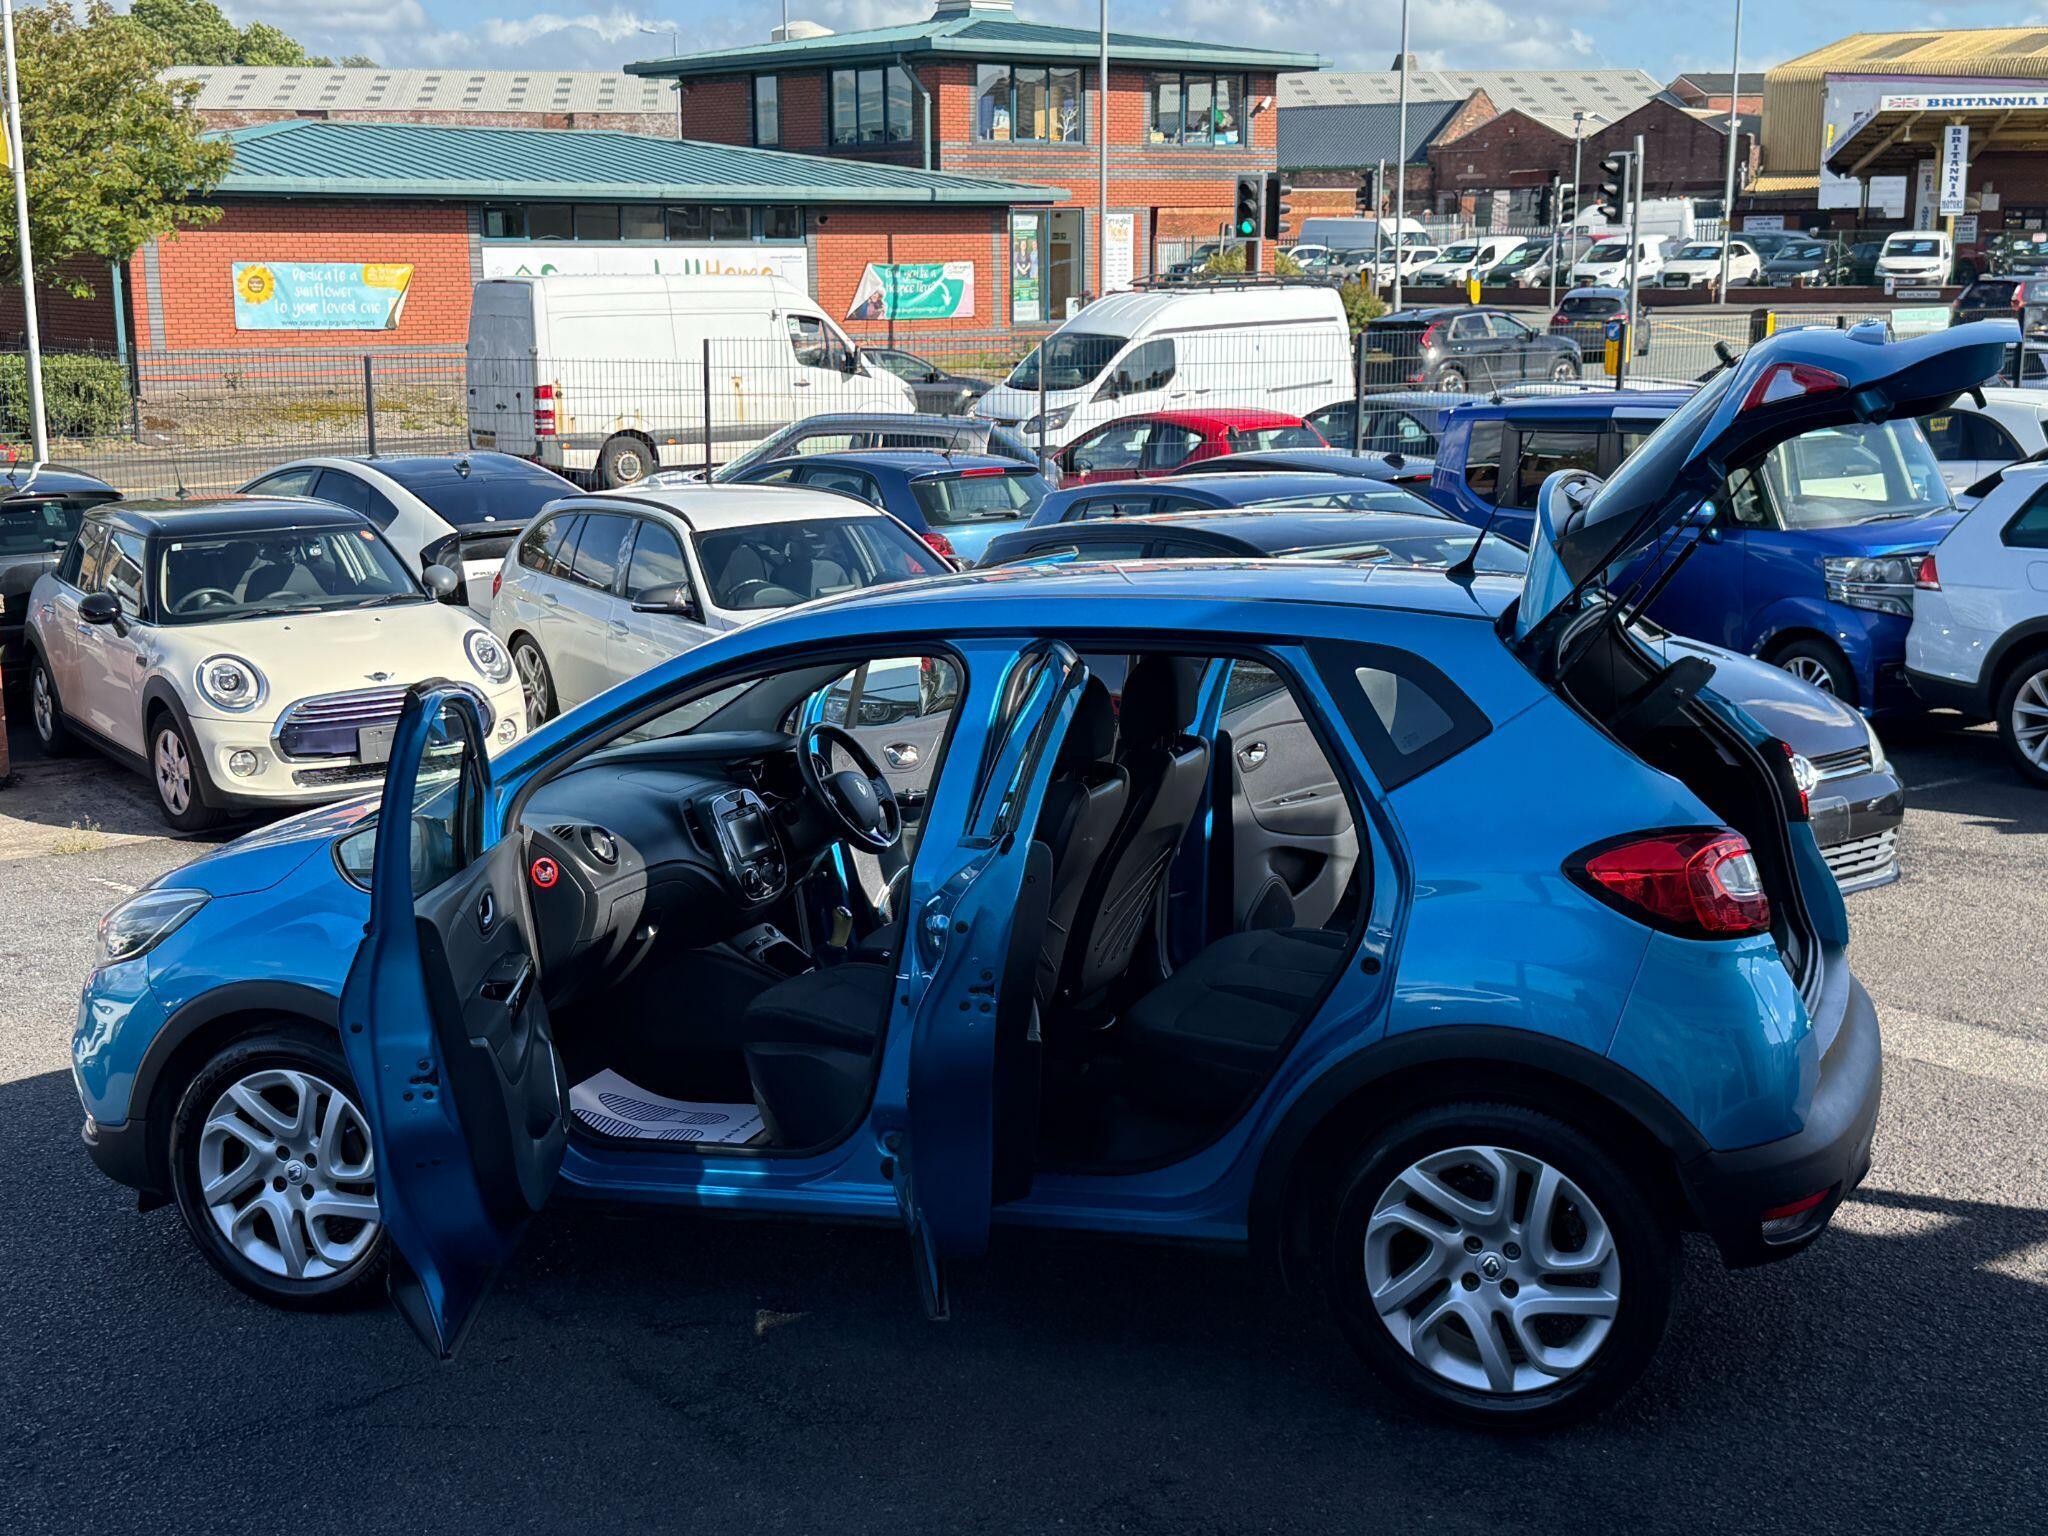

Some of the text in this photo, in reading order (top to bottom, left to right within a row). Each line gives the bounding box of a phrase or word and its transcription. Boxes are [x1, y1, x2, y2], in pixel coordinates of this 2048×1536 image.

[1926, 96, 2037, 107] BRITANNIA
[1948, 128, 1961, 198] BRITANNIA
[1941, 199, 1963, 208] MOTORS
[293, 267, 346, 282] Dedicate
[349, 271, 358, 282] a
[295, 282, 352, 298] sunflower
[274, 298, 381, 318] to your loved one
